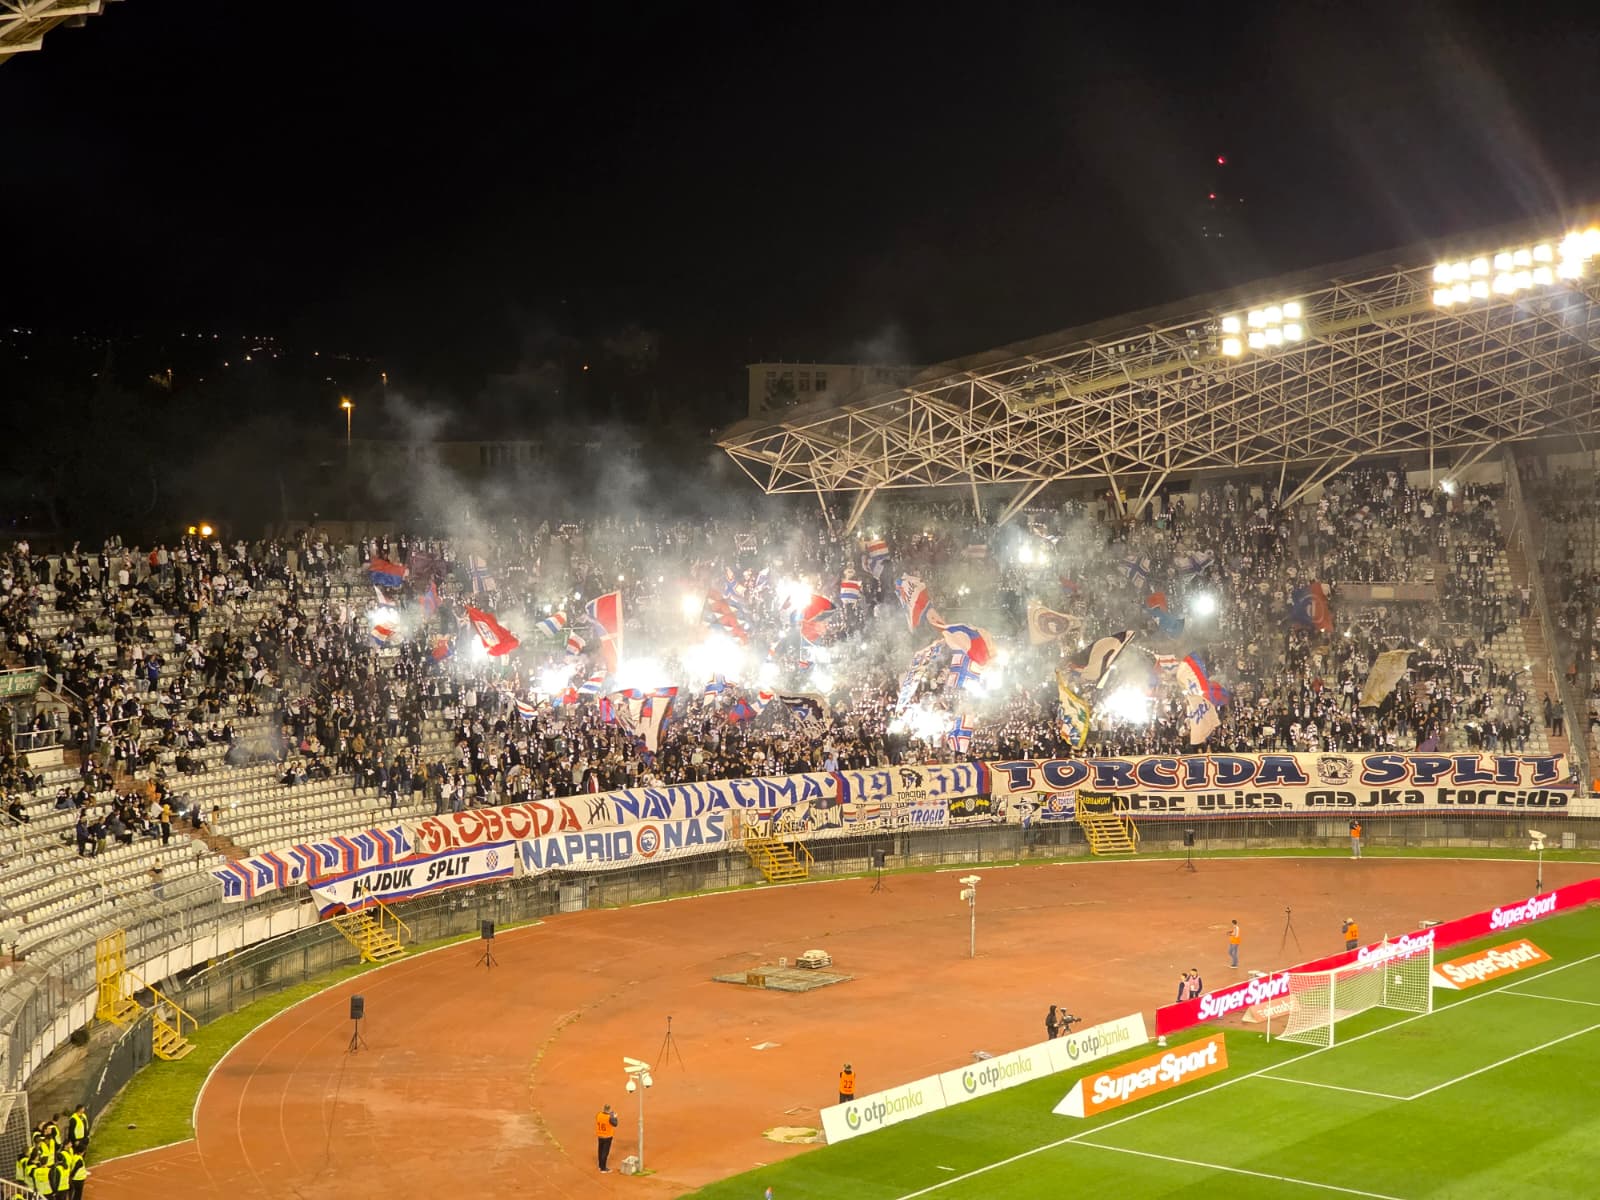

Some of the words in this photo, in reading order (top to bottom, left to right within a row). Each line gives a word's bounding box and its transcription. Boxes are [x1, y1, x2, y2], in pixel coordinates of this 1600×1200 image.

[992, 754, 1310, 792] TORCIDA
[1360, 753, 1565, 786] SPLIT
[663, 811, 724, 848] NAŠ
[351, 868, 414, 901] HAJDUK
[426, 855, 471, 882] SPLIT
[1489, 892, 1557, 929] SuperSport
[1442, 943, 1540, 982] SuperSport
[1197, 971, 1291, 1020] SuperSport
[1091, 1041, 1218, 1104] SuperSport
